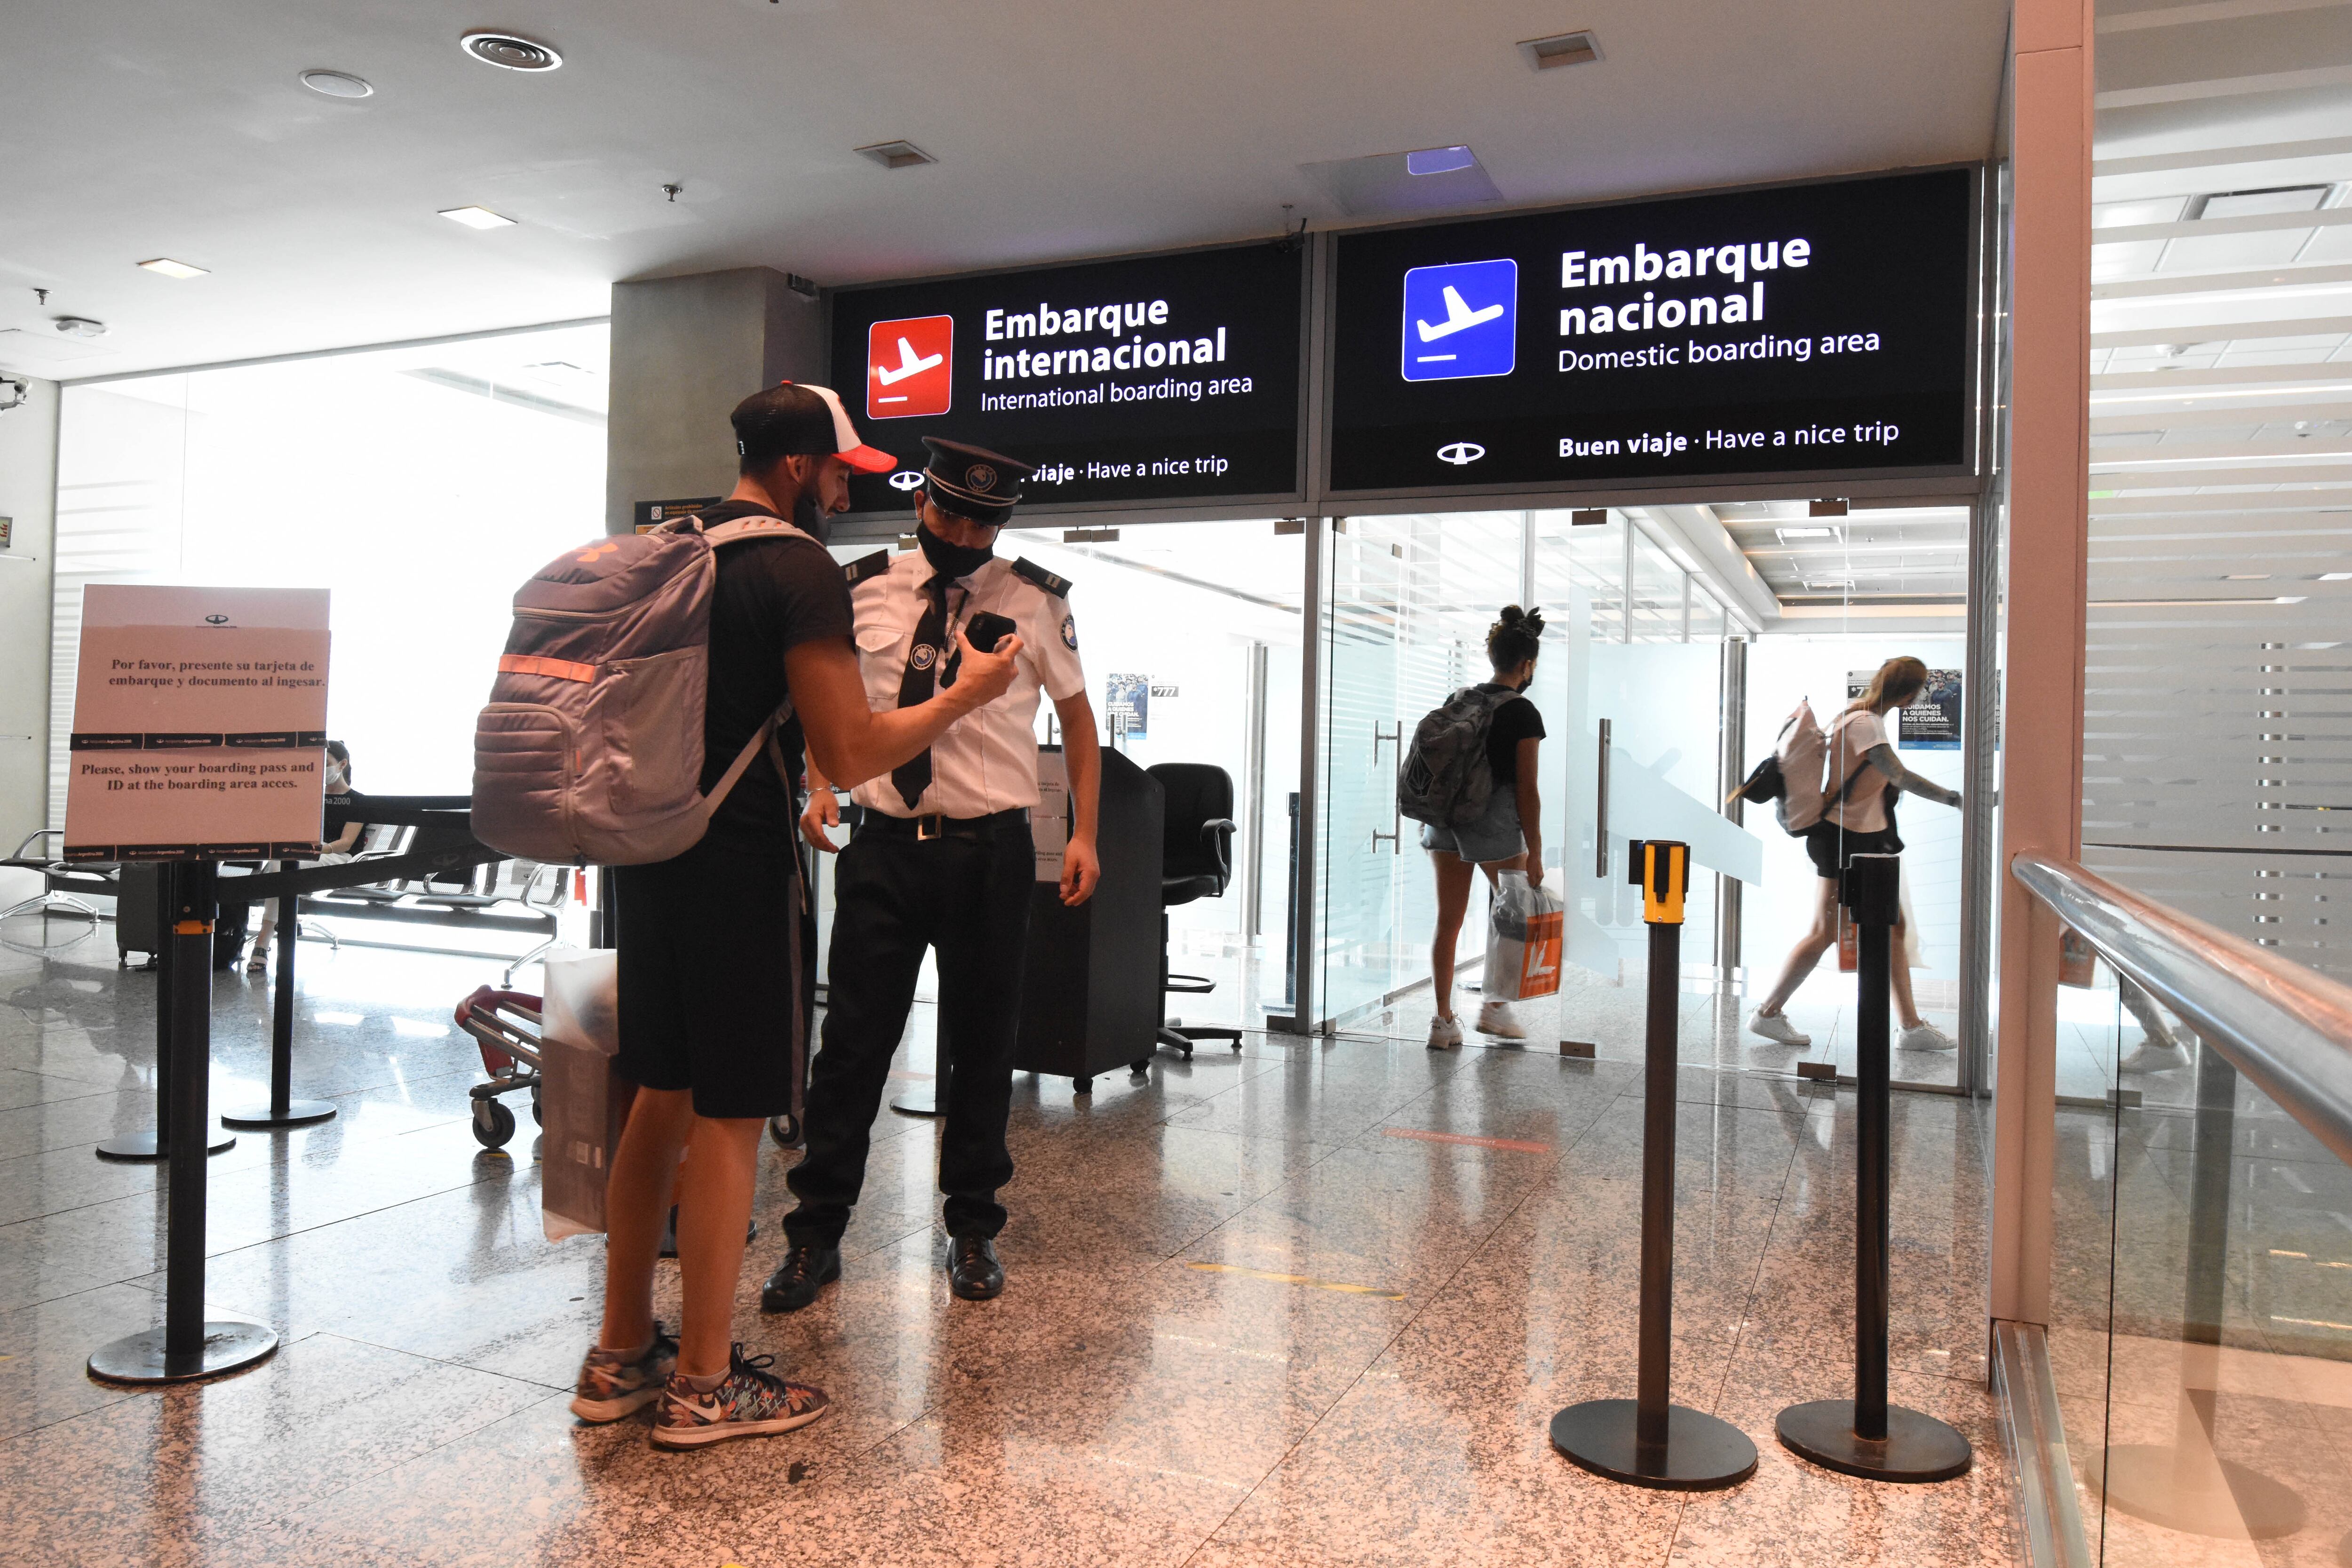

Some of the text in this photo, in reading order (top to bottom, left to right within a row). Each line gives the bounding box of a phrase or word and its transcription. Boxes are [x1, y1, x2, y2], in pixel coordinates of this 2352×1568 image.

[1562, 239, 1810, 288] Embarque
[986, 300, 1168, 340] Embarque
[1560, 280, 1764, 335] nacional
[985, 327, 1225, 380] internacional
[1559, 334, 1879, 372] Domestic boarding area
[982, 378, 1252, 411] International boarding area
[1560, 421, 1899, 457] Buen viaje Have a nice trip
[1088, 462, 1131, 478] Have
[1136, 464, 1145, 476] a
[1153, 458, 1190, 475] nice
[1196, 455, 1228, 476] trip
[109, 676, 325, 688] embarque y documento al ingesar.
[112, 660, 133, 669] Por
[139, 660, 175, 671] favor,
[179, 662, 233, 672] presente
[255, 662, 295, 673] tarjeta
[82, 763, 313, 776] Please, show your boarding pass and
[108, 780, 124, 790] ID
[144, 780, 163, 789] the
[168, 779, 225, 791] boarding
